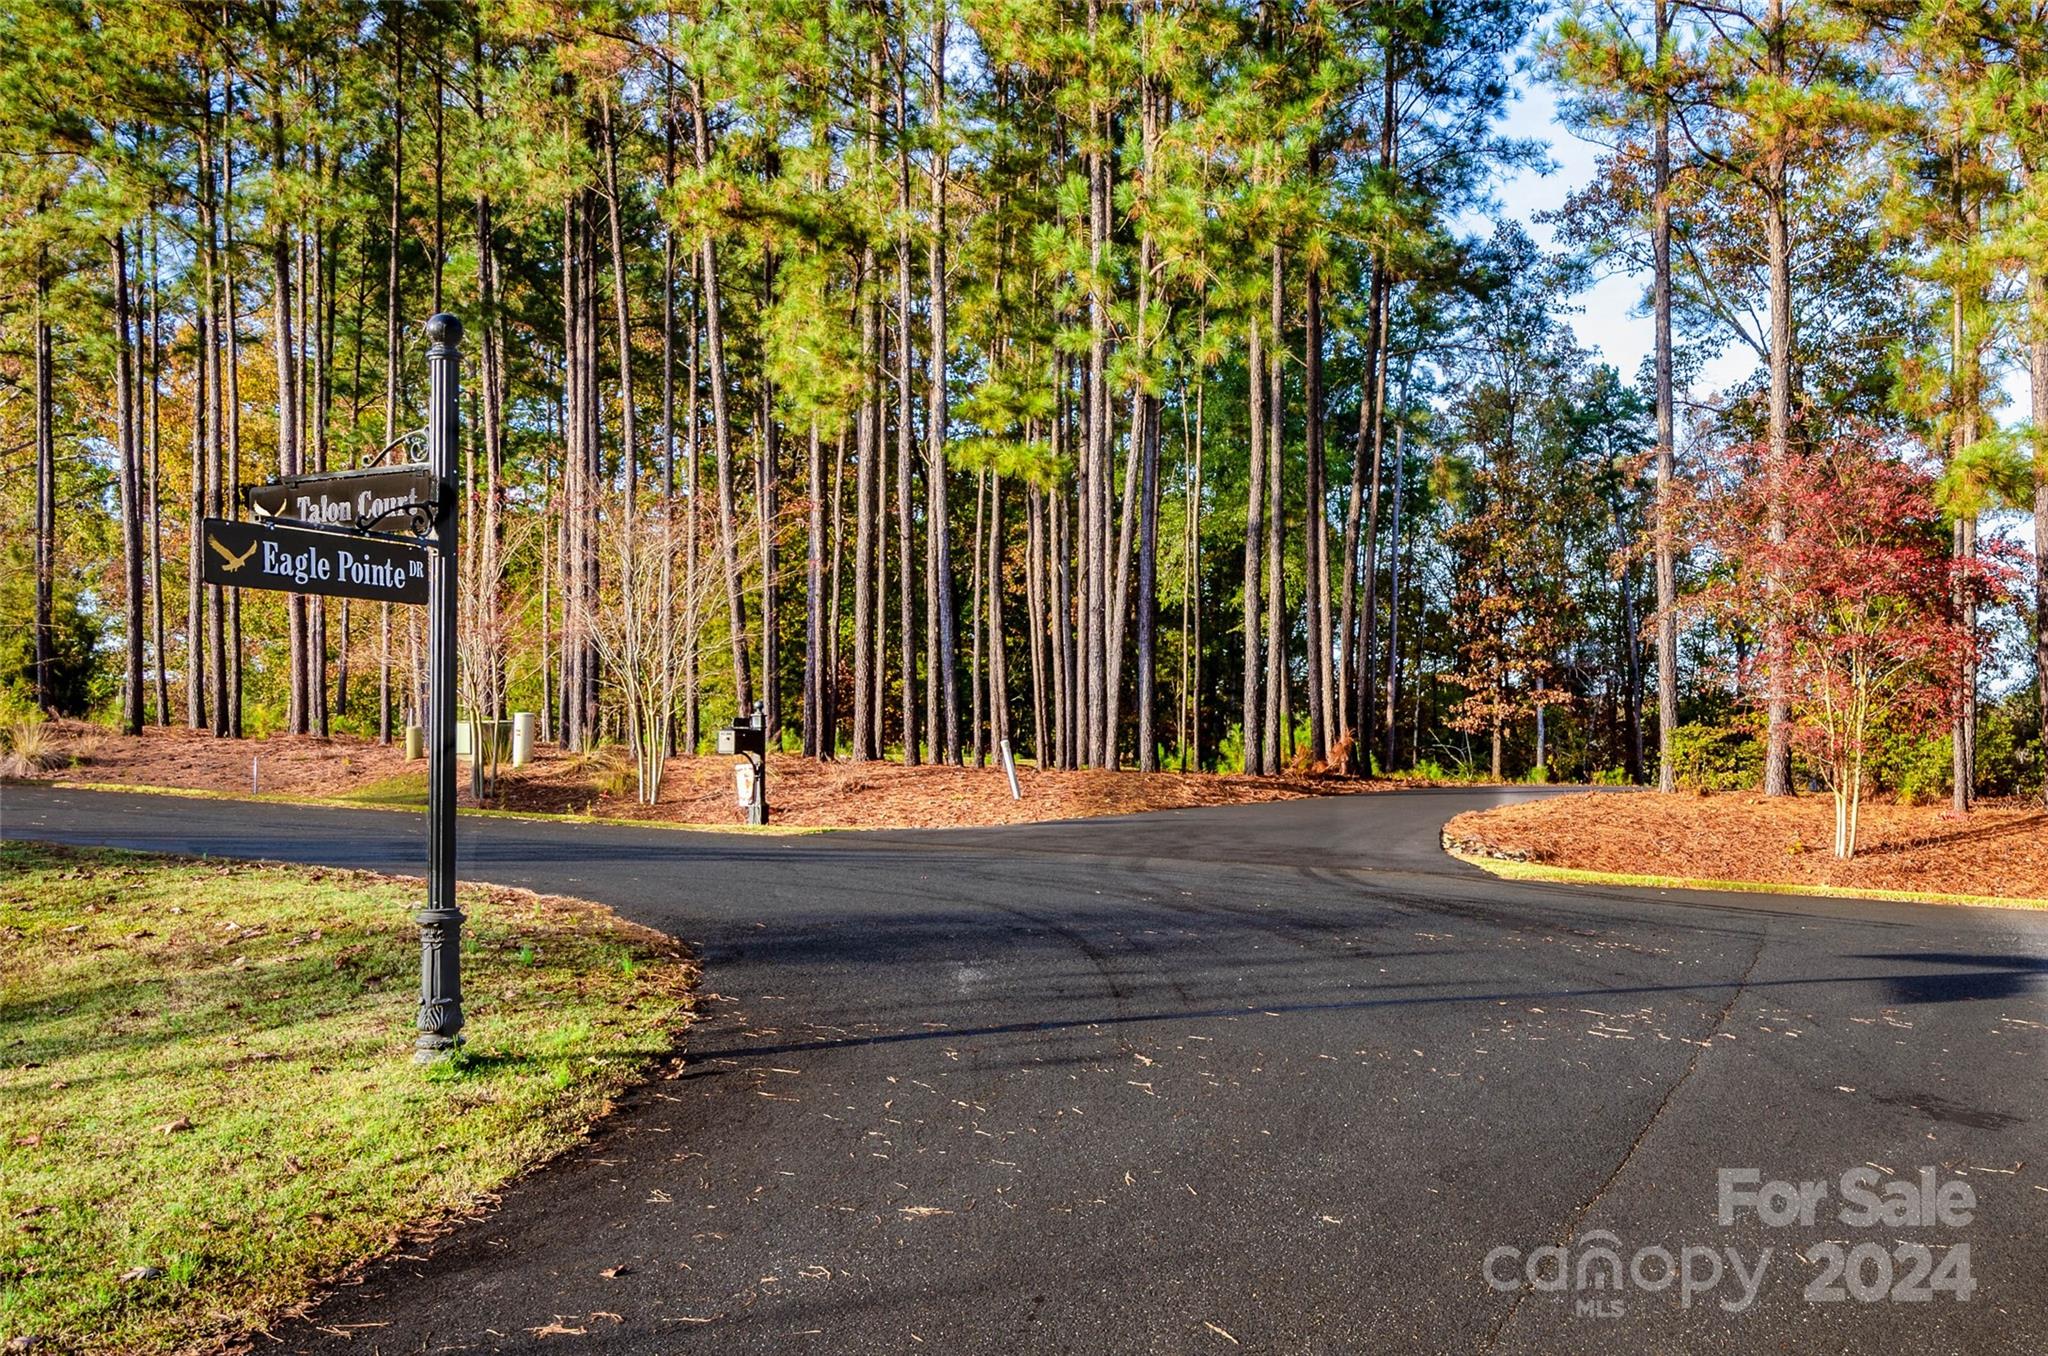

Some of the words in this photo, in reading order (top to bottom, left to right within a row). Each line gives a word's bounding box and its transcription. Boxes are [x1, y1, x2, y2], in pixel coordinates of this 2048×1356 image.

[297, 494, 352, 523] Talon
[357, 487, 418, 519] Court
[262, 541, 330, 584] Eagle
[338, 551, 406, 588] Pointe
[409, 560, 424, 578] DR
